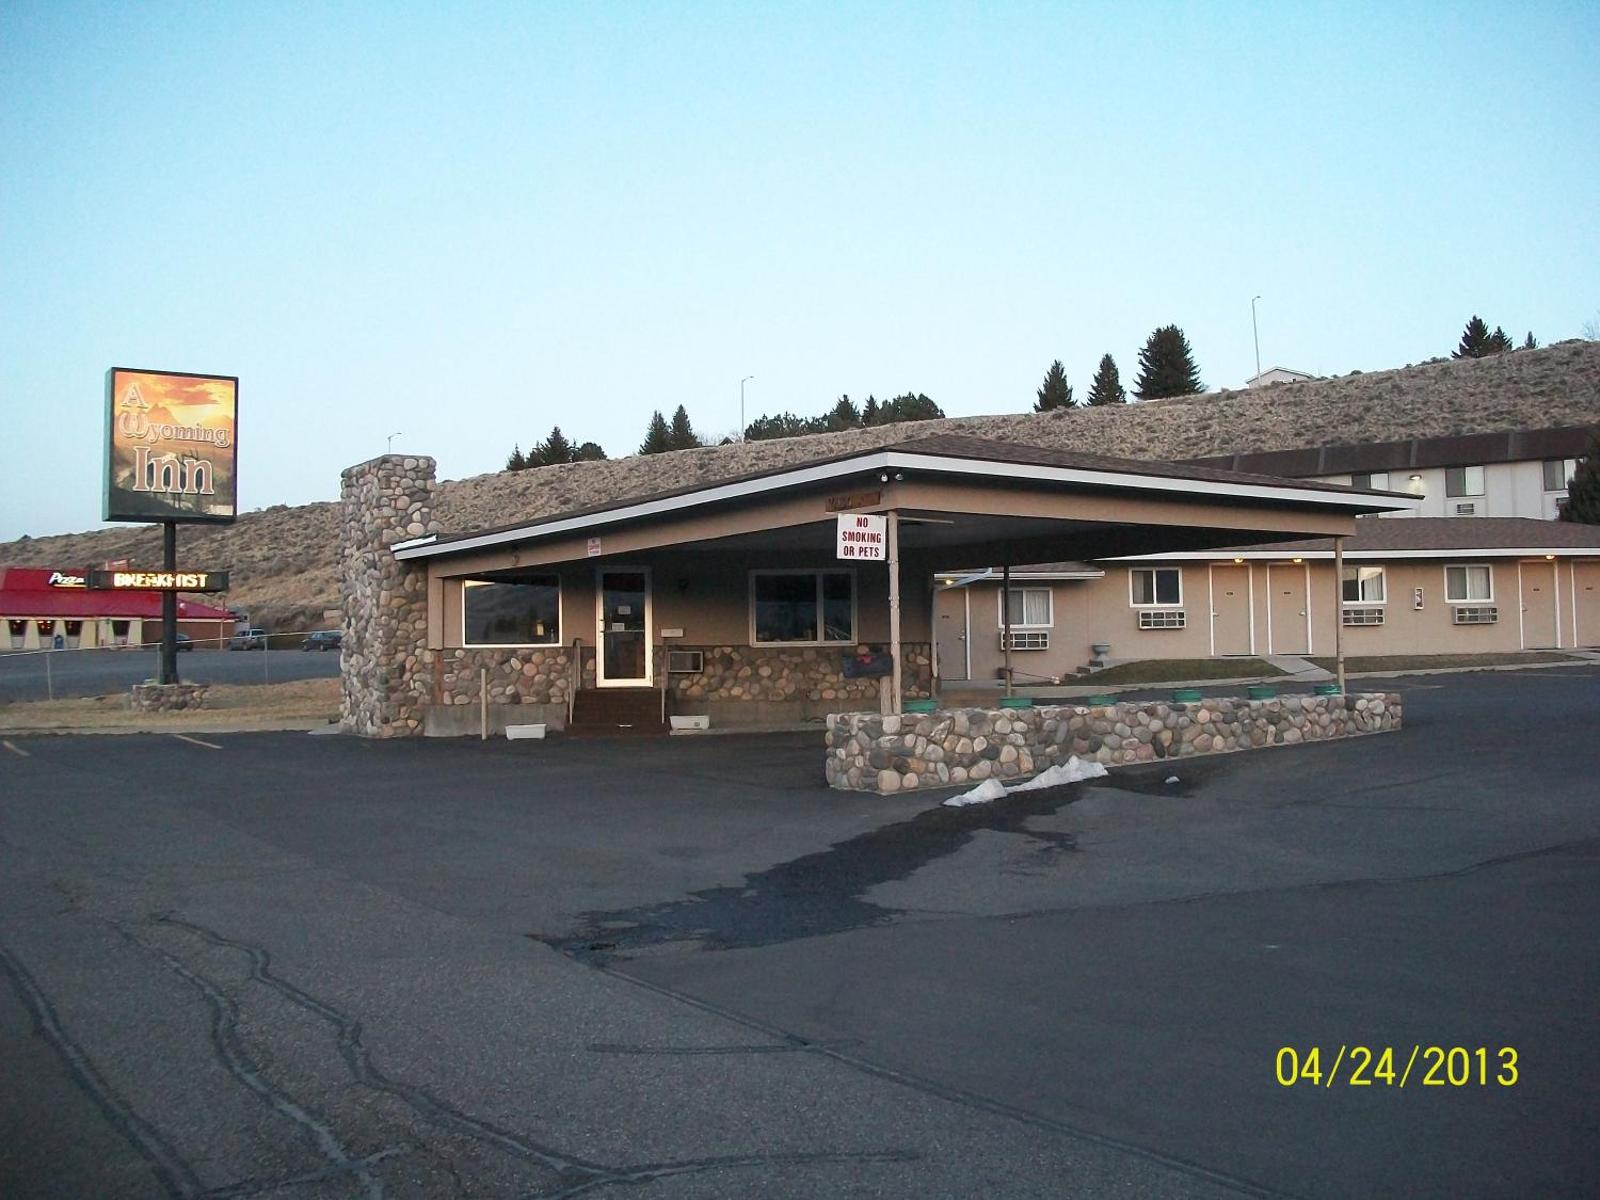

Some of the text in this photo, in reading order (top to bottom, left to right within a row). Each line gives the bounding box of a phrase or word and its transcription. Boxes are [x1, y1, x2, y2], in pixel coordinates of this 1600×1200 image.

[122, 383, 148, 409] A
[120, 411, 230, 448] Wyoming
[133, 446, 215, 495] Inn
[856, 517, 868, 528] NO
[842, 531, 881, 543] SMOKING
[843, 545, 879, 557] OR PETS
